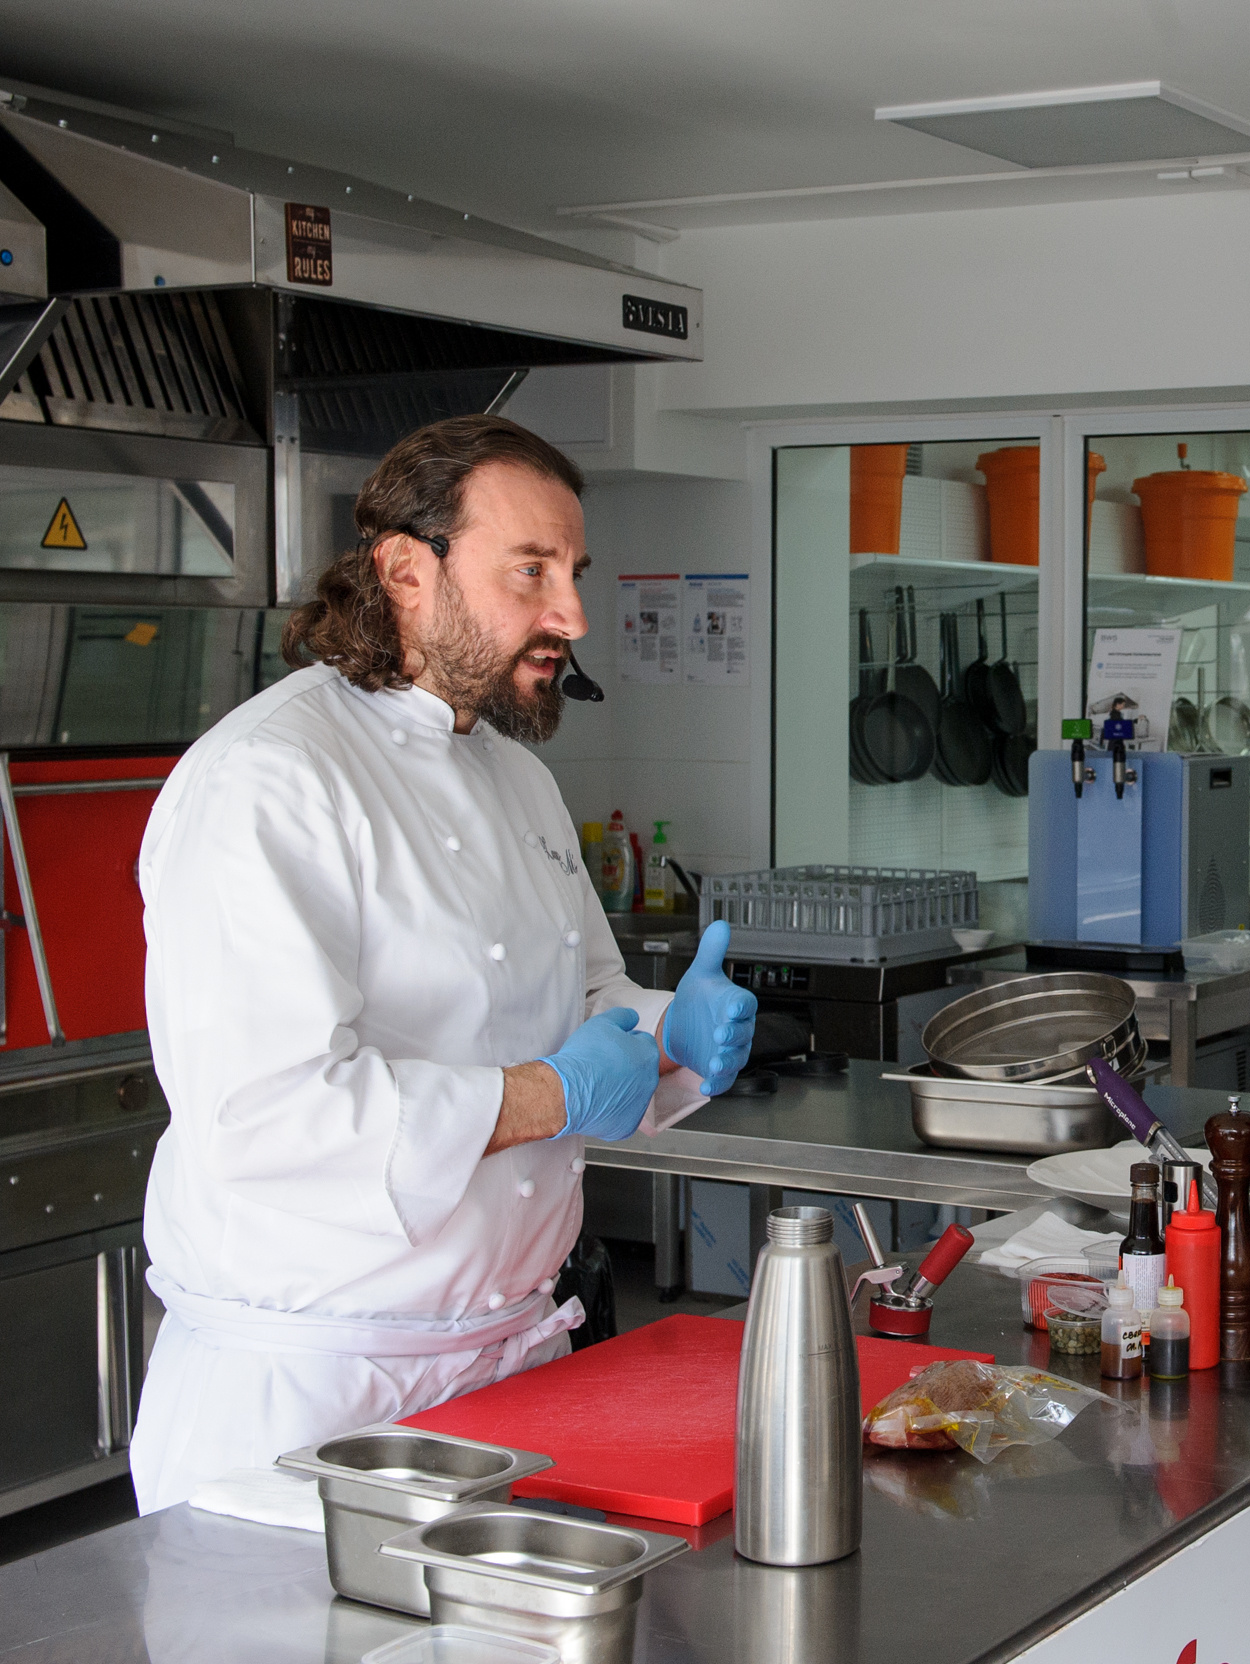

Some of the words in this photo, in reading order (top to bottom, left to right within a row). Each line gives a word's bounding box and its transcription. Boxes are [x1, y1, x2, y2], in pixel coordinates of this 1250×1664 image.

[291, 220, 330, 240] KITCHEN
[294, 257, 330, 281] RULES
[1103, 1091, 1136, 1130] Microplane
